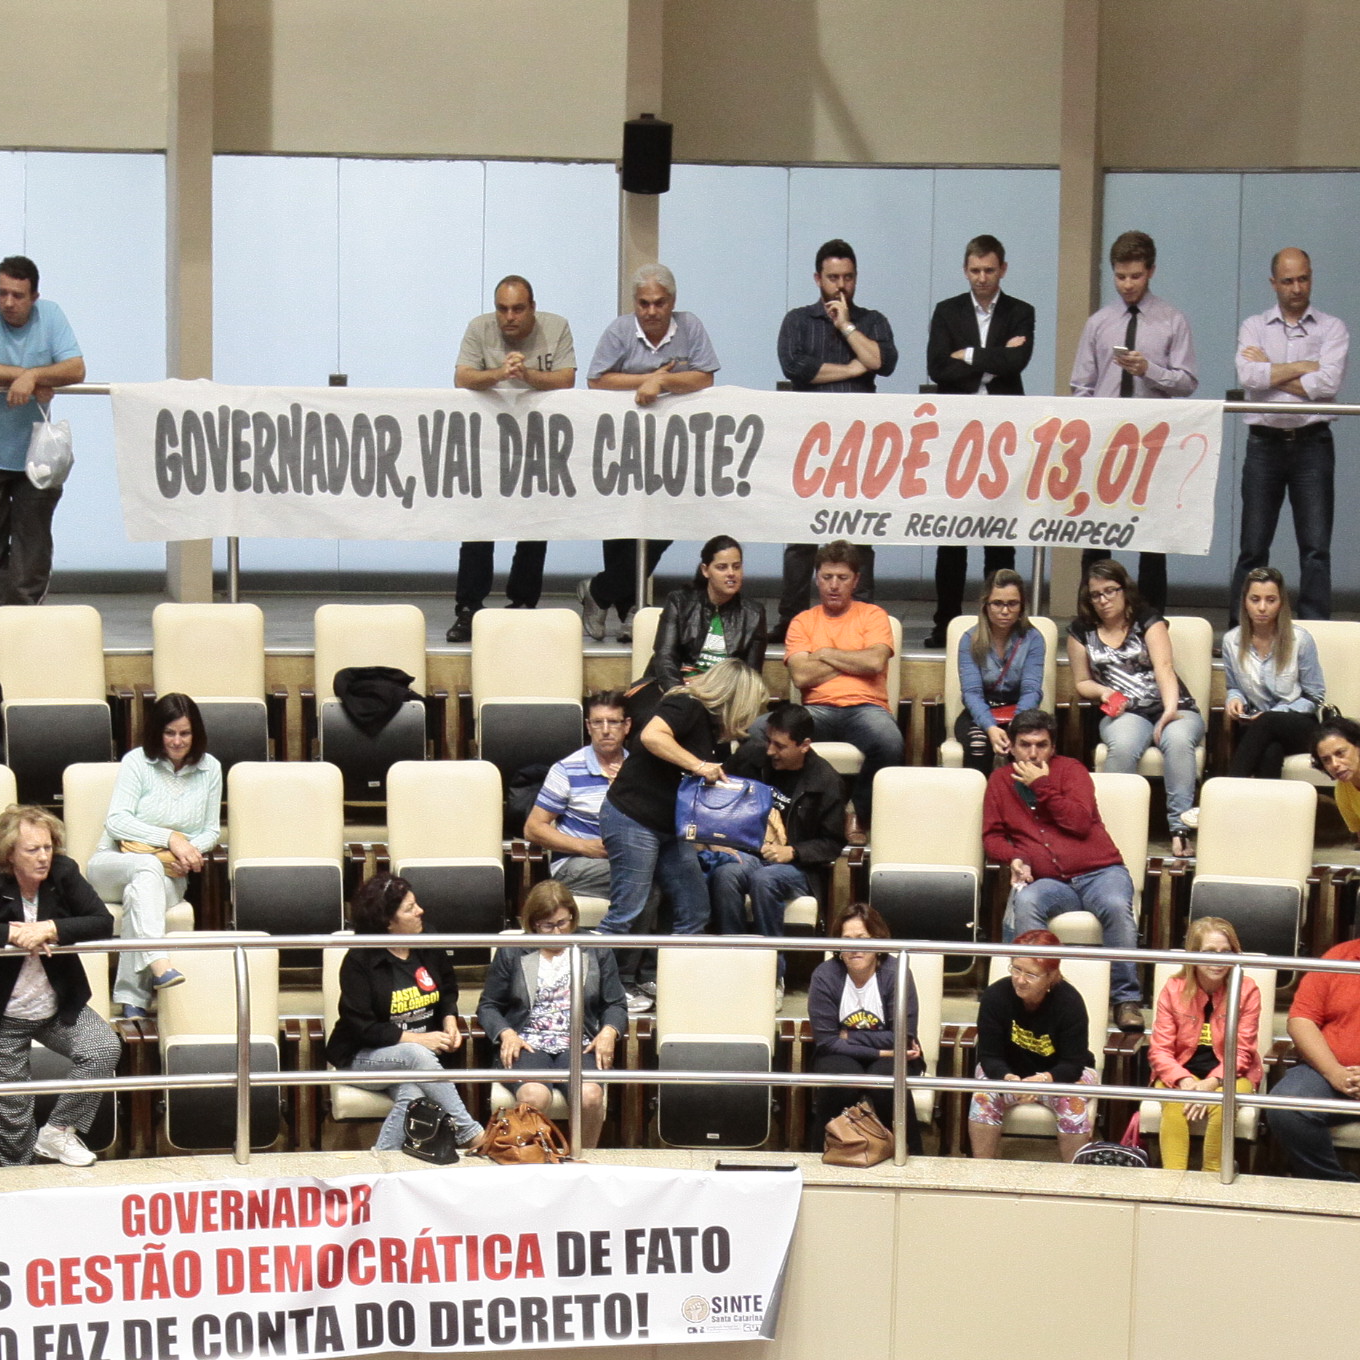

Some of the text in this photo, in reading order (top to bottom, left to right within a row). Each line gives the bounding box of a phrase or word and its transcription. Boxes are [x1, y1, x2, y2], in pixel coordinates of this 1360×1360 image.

[154, 403, 416, 510] GOVERNADOR,
[418, 409, 483, 499] VAI
[496, 411, 577, 498] DAR
[592, 410, 765, 499] CALOTE?
[791, 402, 940, 500] CADÊ
[945, 419, 1018, 500] OS
[810, 509, 1140, 548] SINTE REGIONAL CHAPECÓ
[390, 991, 440, 1014] COLOMBO!
[121, 1183, 372, 1238] GOVERNADOR
[25, 1242, 203, 1308] GESTÃO
[216, 1227, 545, 1297] DEMOCRÁTICA
[556, 1230, 613, 1278] DE
[625, 1226, 732, 1276] FATO
[355, 1299, 417, 1352] DO
[428, 1292, 651, 1349] DECRETO!
[712, 1295, 762, 1314] SINTE
[733, 1314, 763, 1322] Catarina
